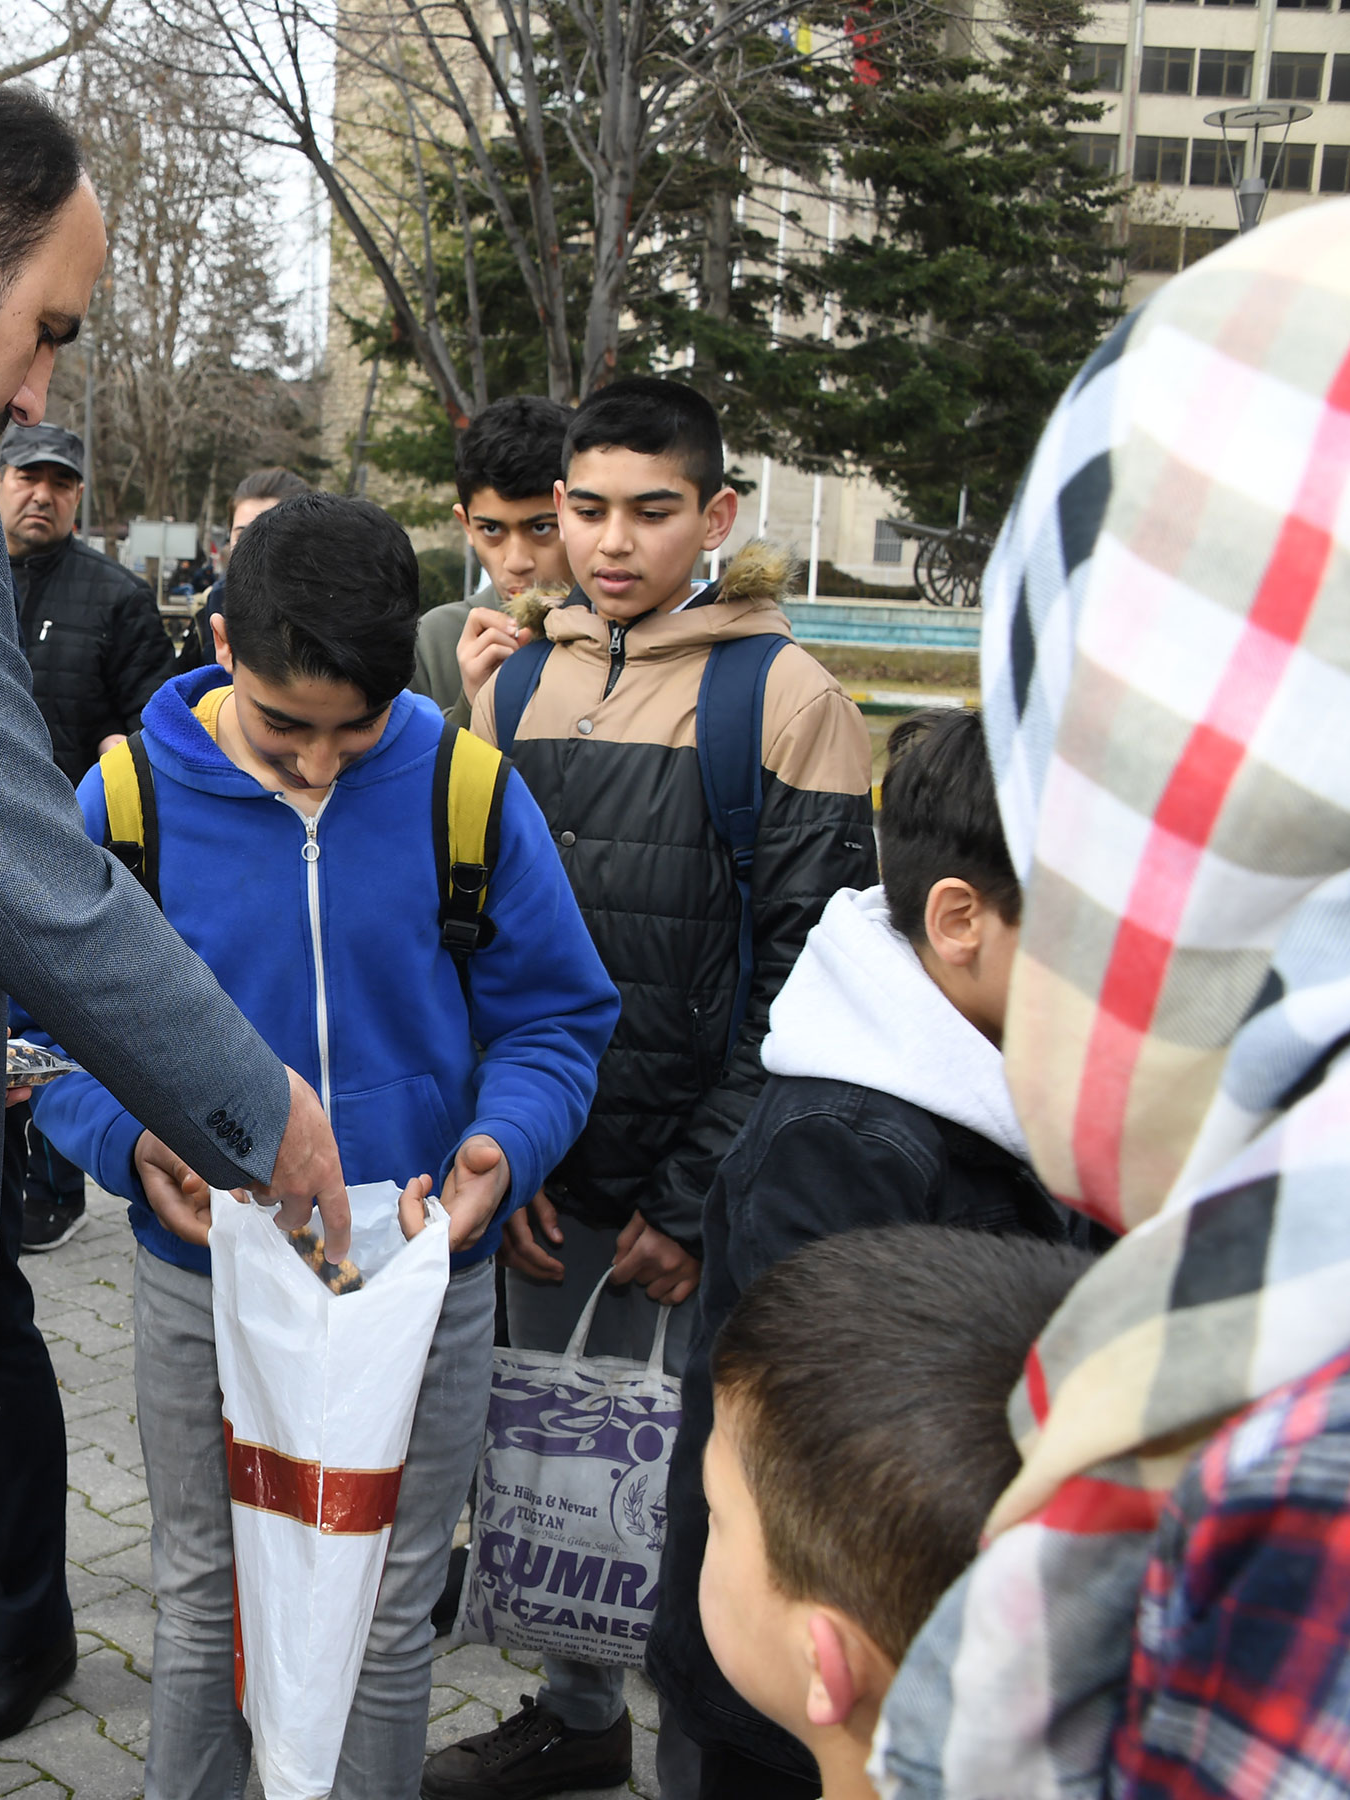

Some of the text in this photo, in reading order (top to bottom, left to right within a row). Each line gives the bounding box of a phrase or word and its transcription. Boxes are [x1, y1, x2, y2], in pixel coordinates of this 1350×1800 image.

[513, 1485, 542, 1506] Hülya
[546, 1495, 555, 1508] &
[558, 1497, 598, 1518] Nevzat
[516, 1505, 565, 1531] TUĞYAN
[566, 1536, 591, 1548] Gelen
[623, 1652, 644, 1660] KON
